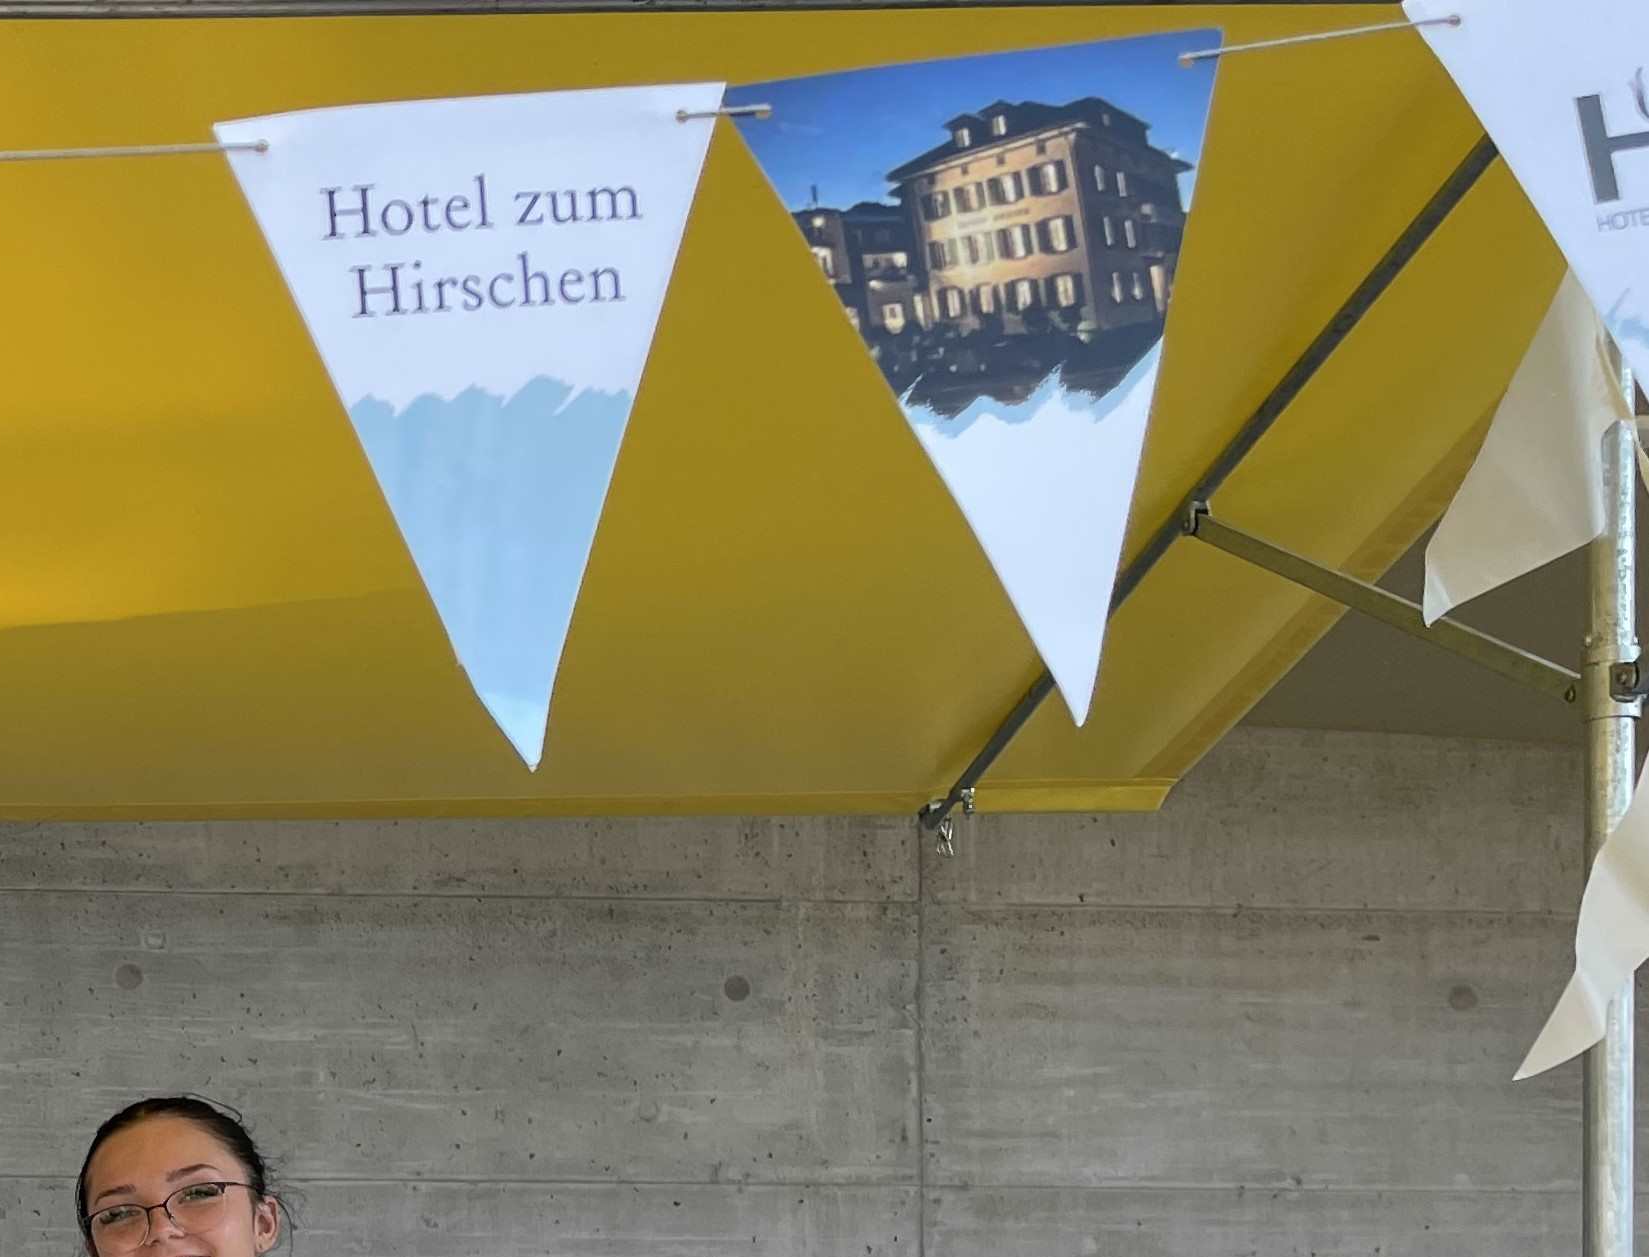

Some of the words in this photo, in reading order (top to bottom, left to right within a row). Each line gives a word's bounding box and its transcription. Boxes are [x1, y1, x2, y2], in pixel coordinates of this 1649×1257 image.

[320, 173, 494, 240] Hotel
[514, 182, 643, 226] zum
[350, 252, 627, 318] Hirschen
